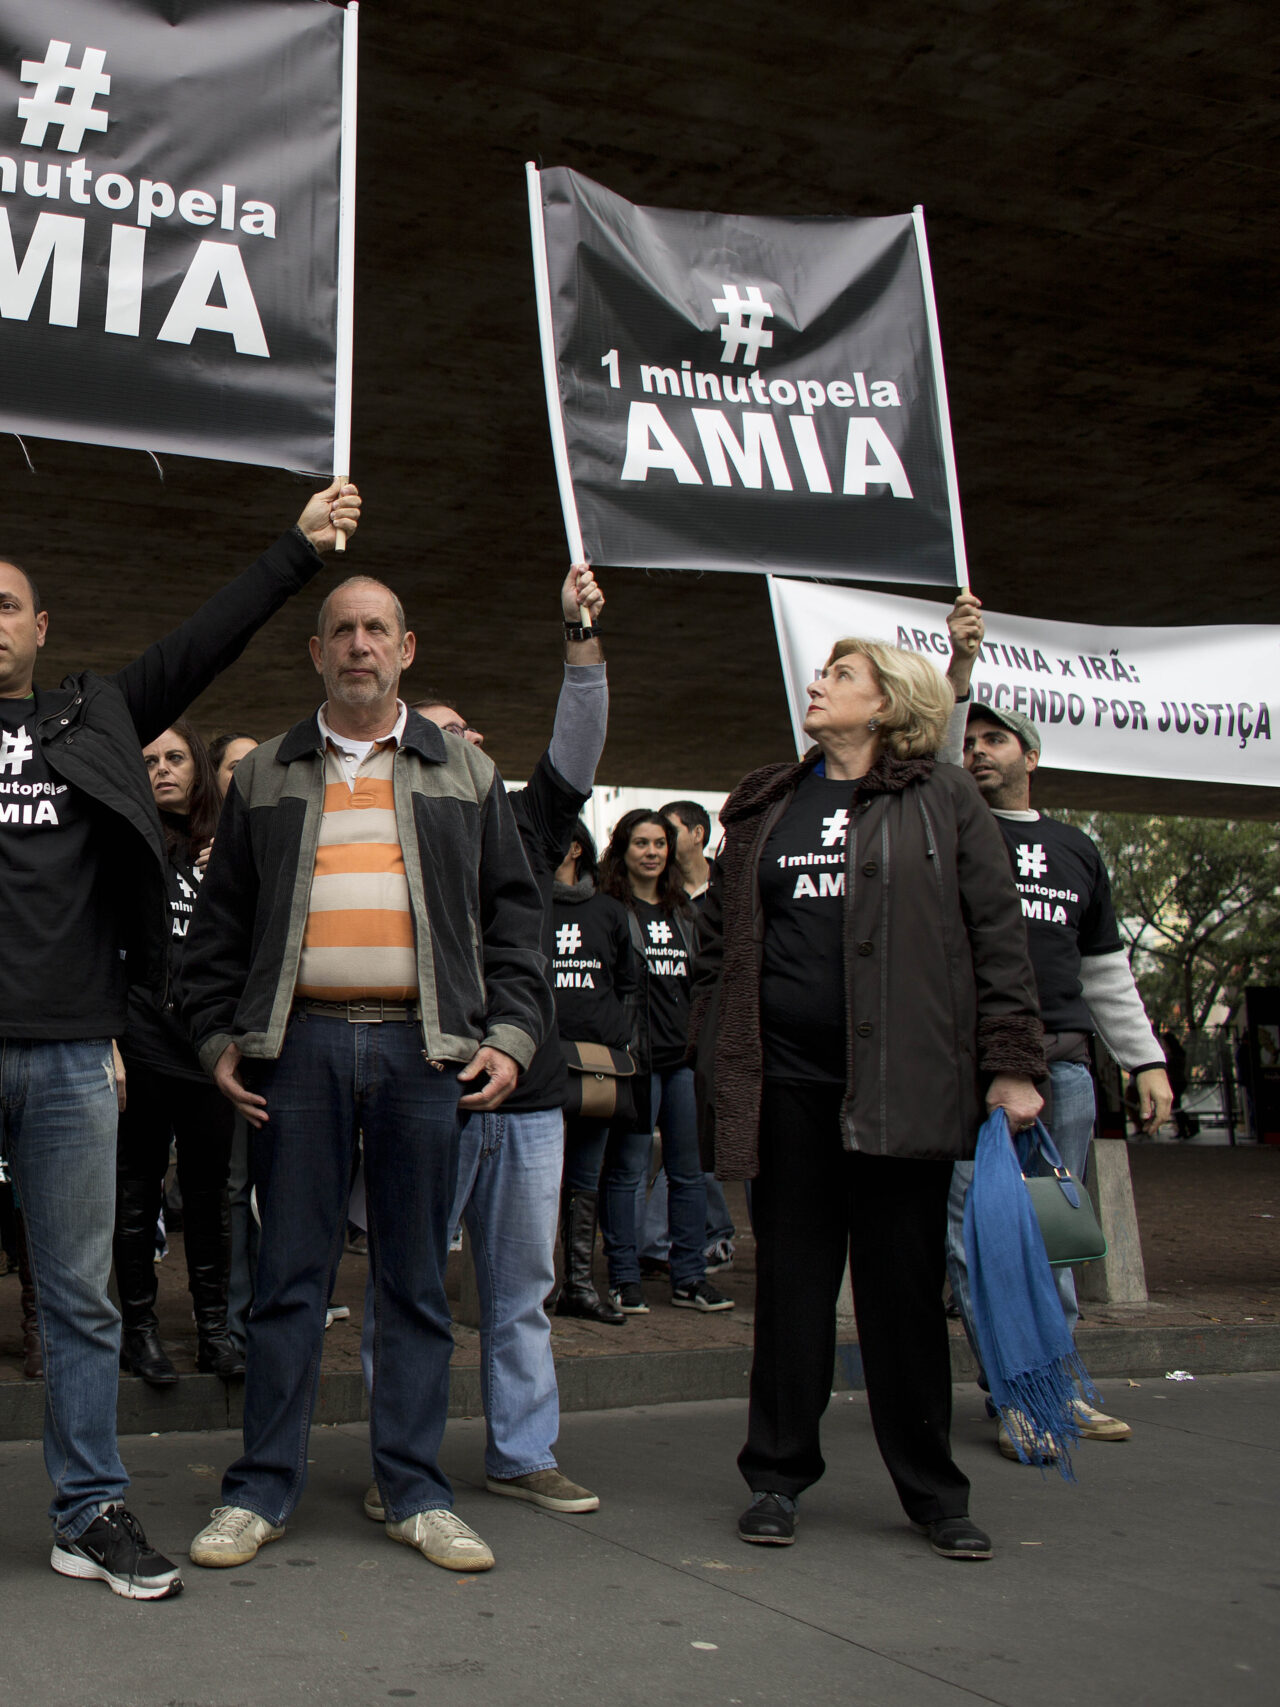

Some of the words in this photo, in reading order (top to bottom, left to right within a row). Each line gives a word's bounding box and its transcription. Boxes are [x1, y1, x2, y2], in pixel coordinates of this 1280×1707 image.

[17, 40, 111, 153] #
[712, 284, 774, 366] #
[601, 349, 620, 389] 1
[640, 361, 901, 415] minutopela
[620, 401, 914, 499] AMIA
[896, 625, 1052, 674] ARGTINA
[1078, 648, 1141, 683] IRÃ:
[970, 681, 1086, 726] RCENDO
[1092, 696, 1149, 730] POR
[1157, 701, 1271, 749] JUSTIÇA
[1016, 844, 1047, 878] #
[556, 923, 582, 954] #
[647, 921, 673, 944] #
[554, 972, 595, 989] MIA
